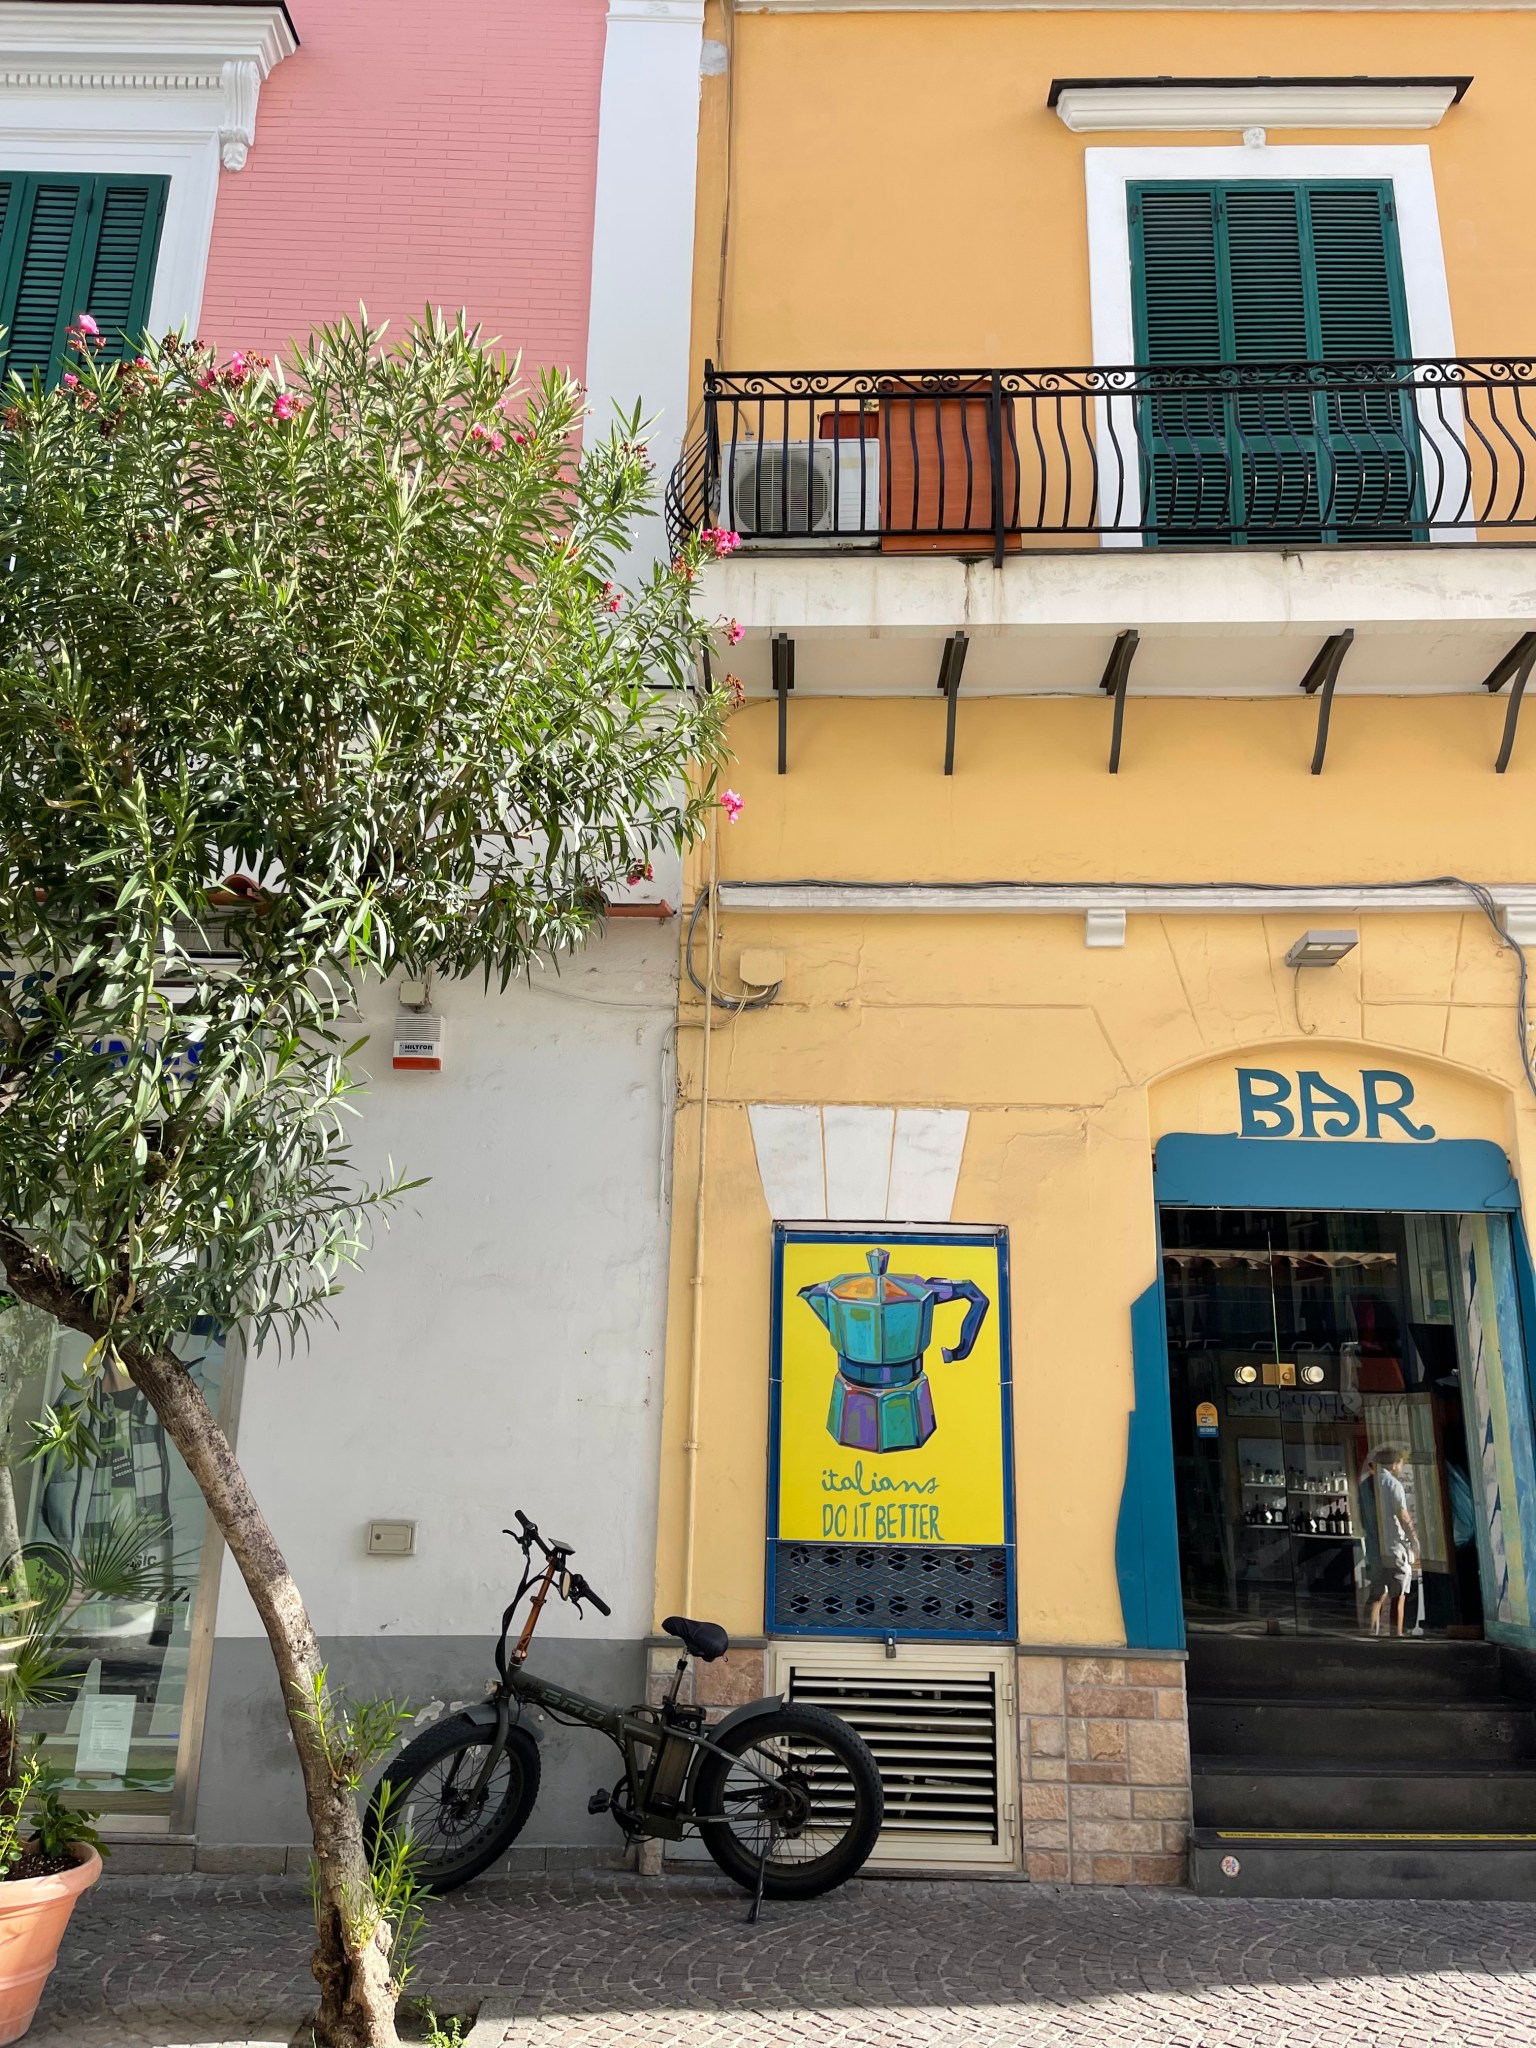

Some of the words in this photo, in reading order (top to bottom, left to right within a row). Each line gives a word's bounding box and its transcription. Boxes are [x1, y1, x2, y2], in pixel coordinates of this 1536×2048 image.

[1234, 1067, 1436, 1141] BAR
[821, 1460, 940, 1496] italians
[822, 1503, 848, 1537] DO
[853, 1502, 872, 1538] IT
[875, 1503, 945, 1541] BETTER
